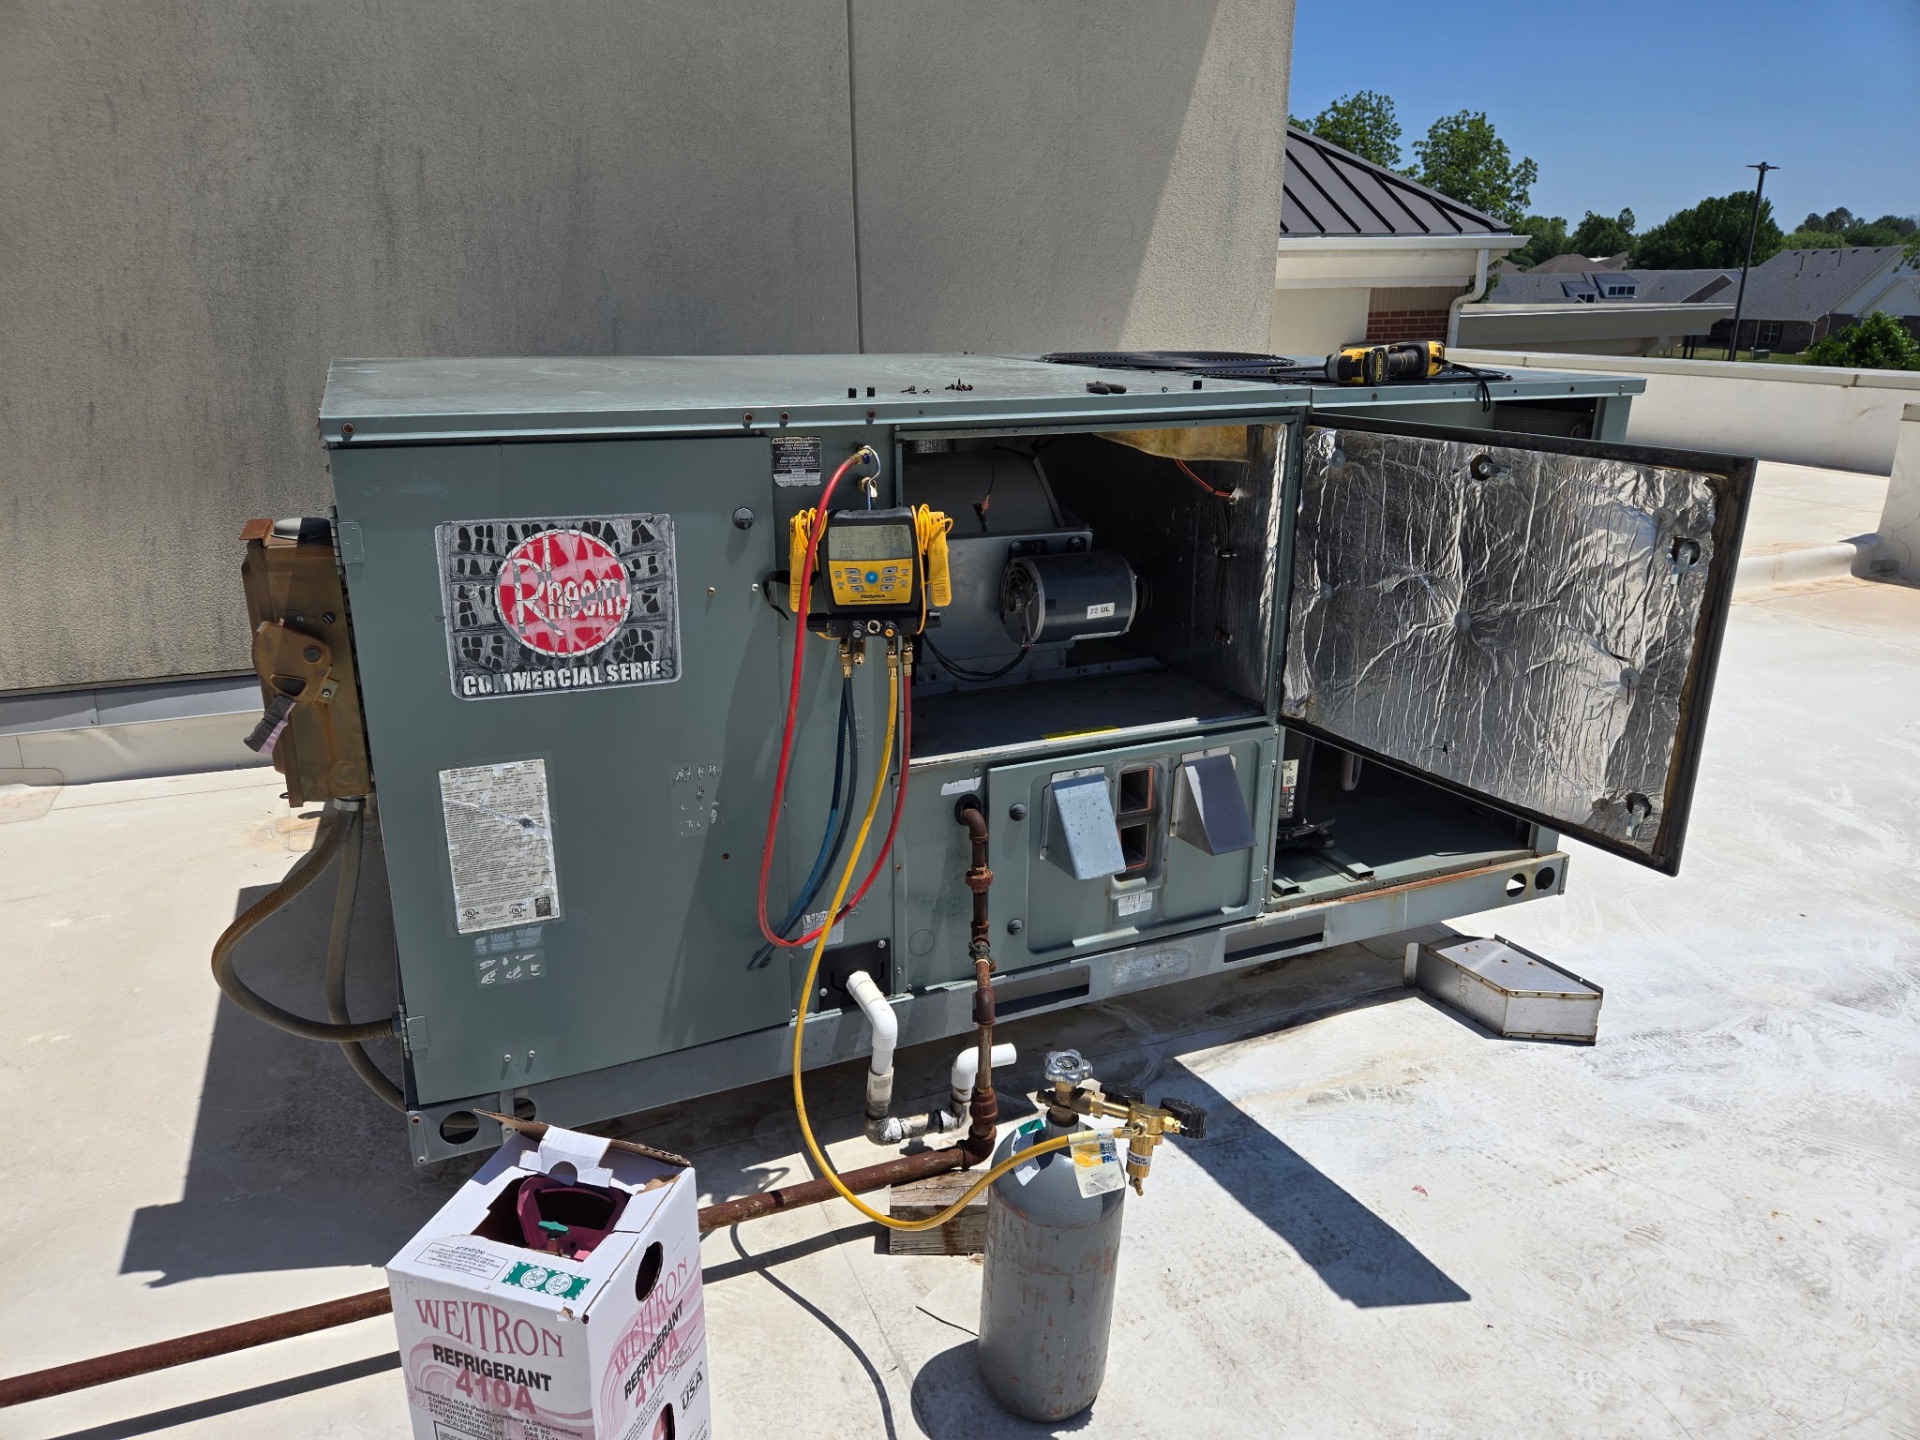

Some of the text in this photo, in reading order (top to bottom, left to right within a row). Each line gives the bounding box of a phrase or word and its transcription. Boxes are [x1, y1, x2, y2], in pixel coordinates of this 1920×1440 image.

[511, 536, 624, 636] Rheem
[462, 658, 674, 697] COMMERCIAL SERIES
[415, 1299, 563, 1357] WEITRON
[615, 1257, 688, 1376] WEITRON
[433, 1344, 552, 1392] REFRIGERANT
[624, 1299, 684, 1401] REFRIGERANT
[635, 1330, 680, 1408] 410A
[428, 1396, 474, 1416] COMPONENTS
[455, 1369, 538, 1415] 410A
[682, 1370, 703, 1411] USA
